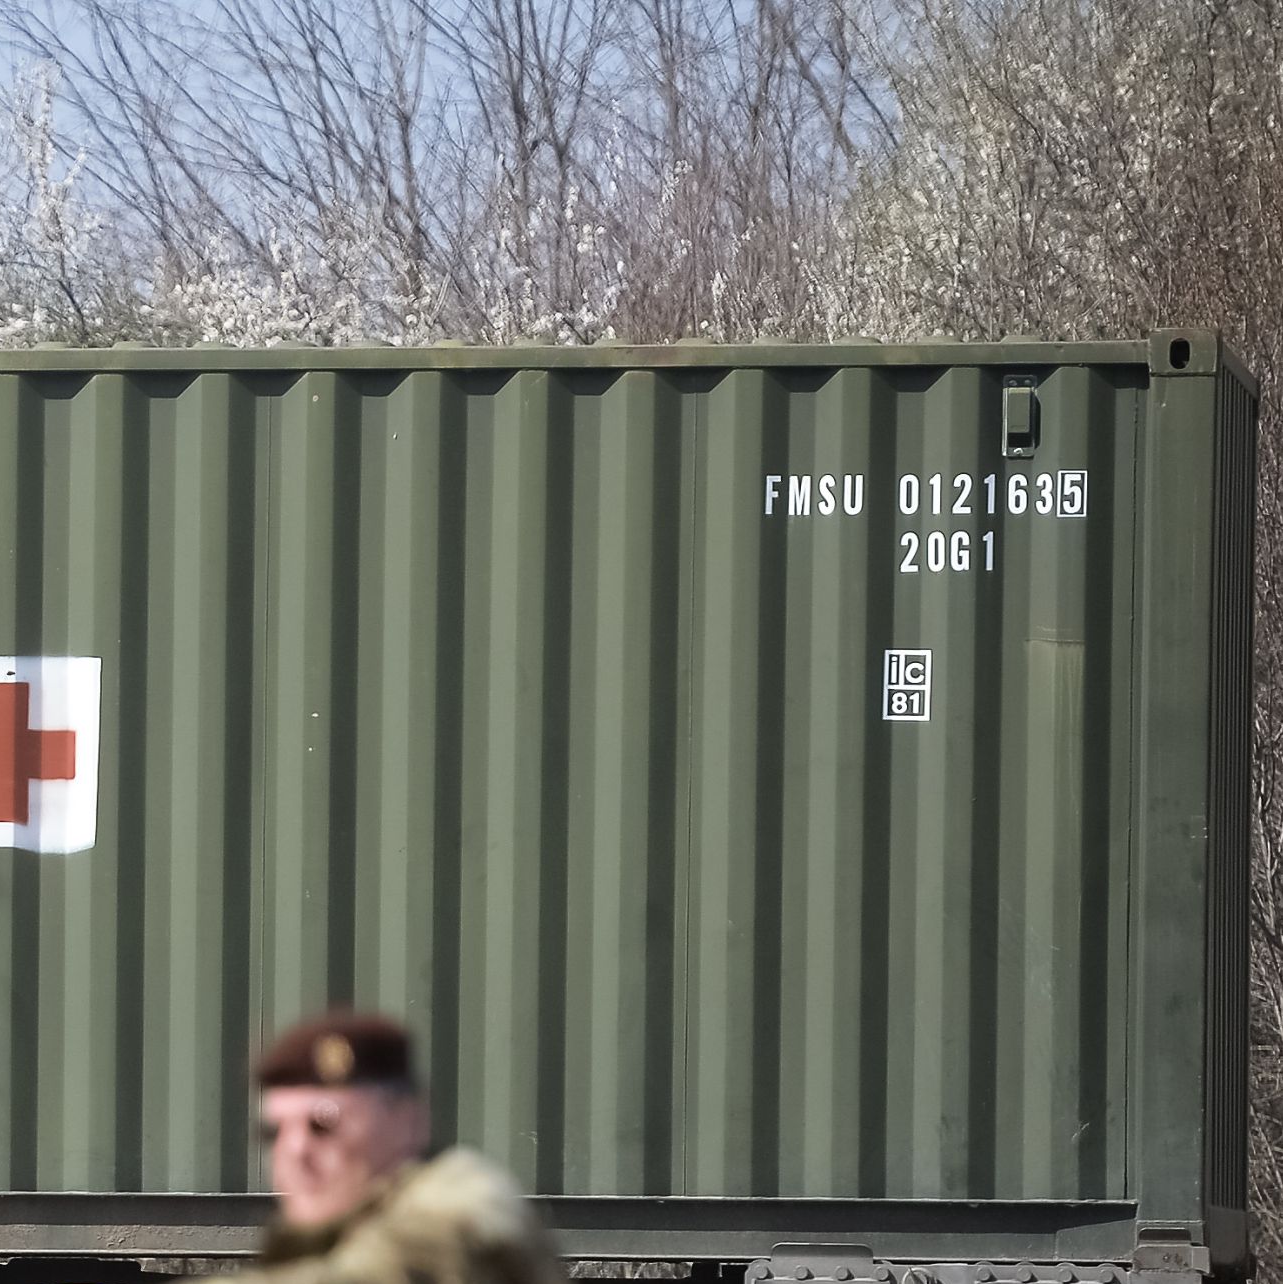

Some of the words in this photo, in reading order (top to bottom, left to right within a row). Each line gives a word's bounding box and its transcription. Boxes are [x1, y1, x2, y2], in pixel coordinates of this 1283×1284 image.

[764, 473, 864, 516] FMSU
[898, 470, 1088, 518] 0121635
[899, 530, 995, 573] 20G1
[890, 692, 921, 717] 81
